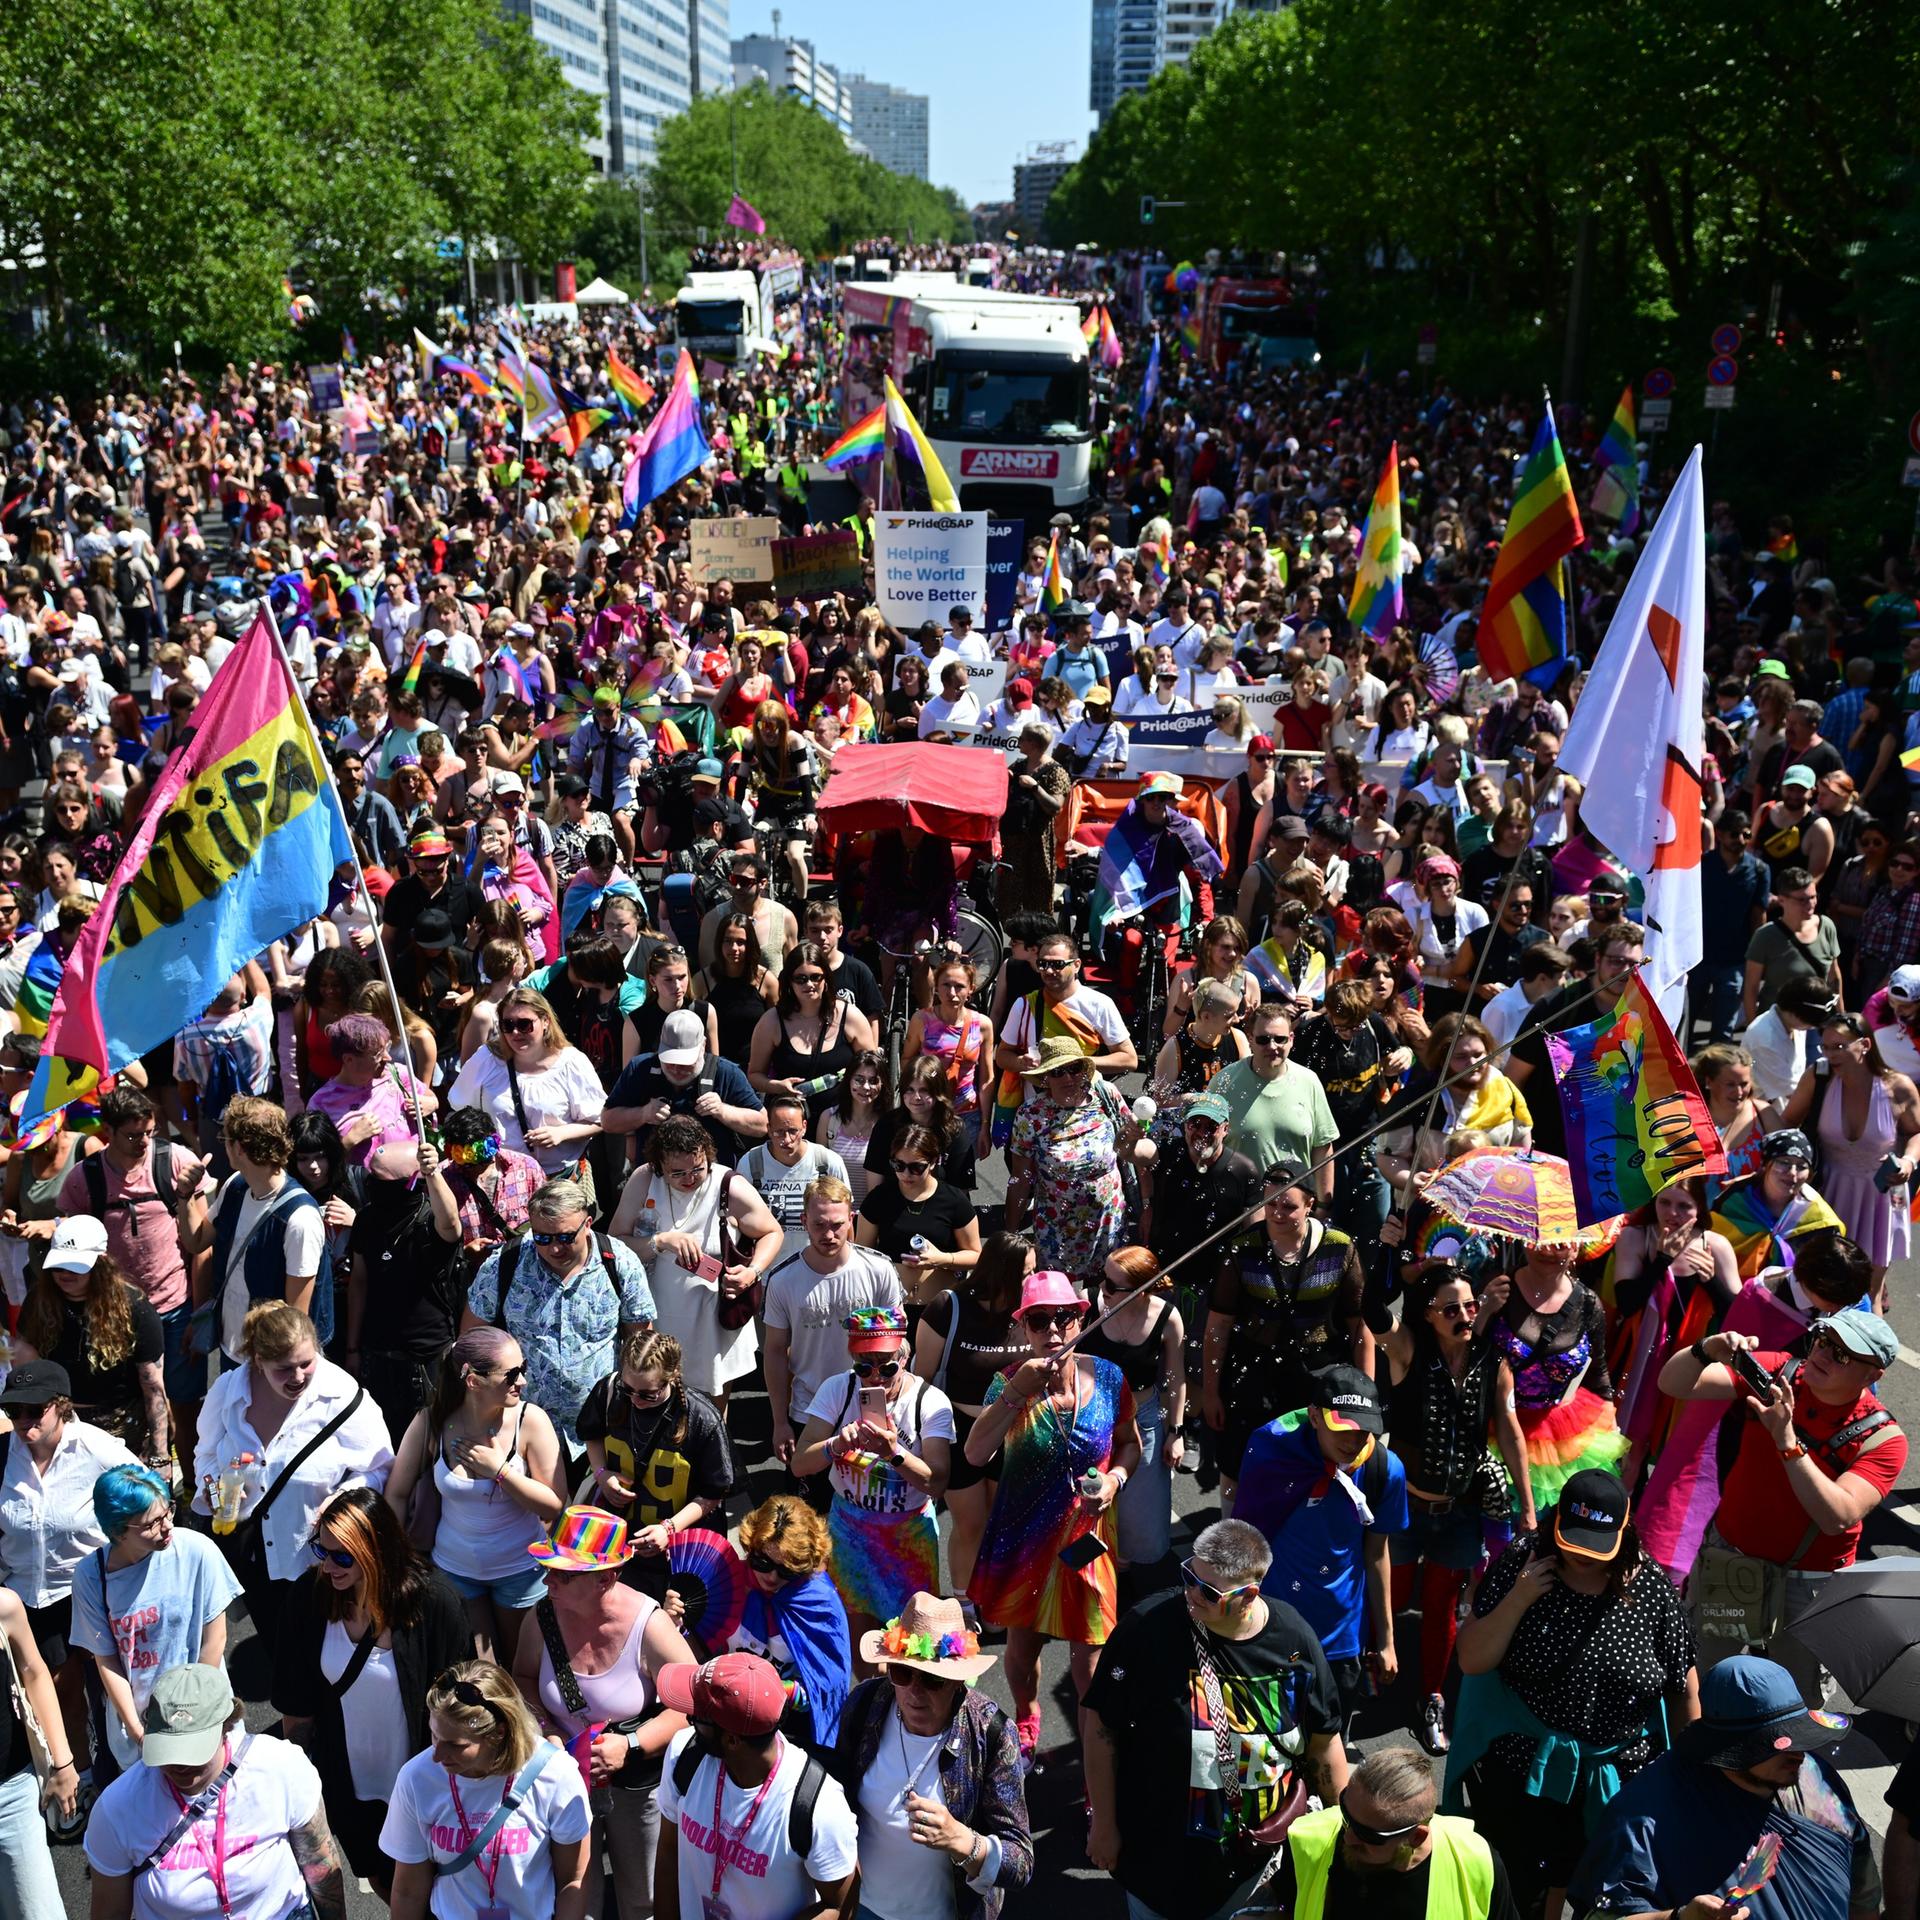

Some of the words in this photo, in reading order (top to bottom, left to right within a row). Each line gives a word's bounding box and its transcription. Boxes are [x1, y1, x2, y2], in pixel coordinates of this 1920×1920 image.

[968, 452, 1053, 474] ARNDT
[908, 517, 974, 531] Pride@SAP
[986, 527, 1012, 537] SAP
[887, 547, 950, 564] Helping
[887, 567, 912, 580] the
[917, 568, 965, 581] World
[888, 588, 923, 600] Love
[928, 588, 977, 601] Better
[1238, 691, 1296, 705] Pride@S
[973, 734, 1021, 749] Pride@
[1643, 1090, 1706, 1182] LOVE
[760, 1183, 802, 1191] ARINA
[960, 1341, 1004, 1353] READING
[1332, 1394, 1372, 1408] DEUTSCHLAND
[1703, 1609, 1745, 1617] ORLANDO
[432, 1825, 531, 1856] VOLUEER
